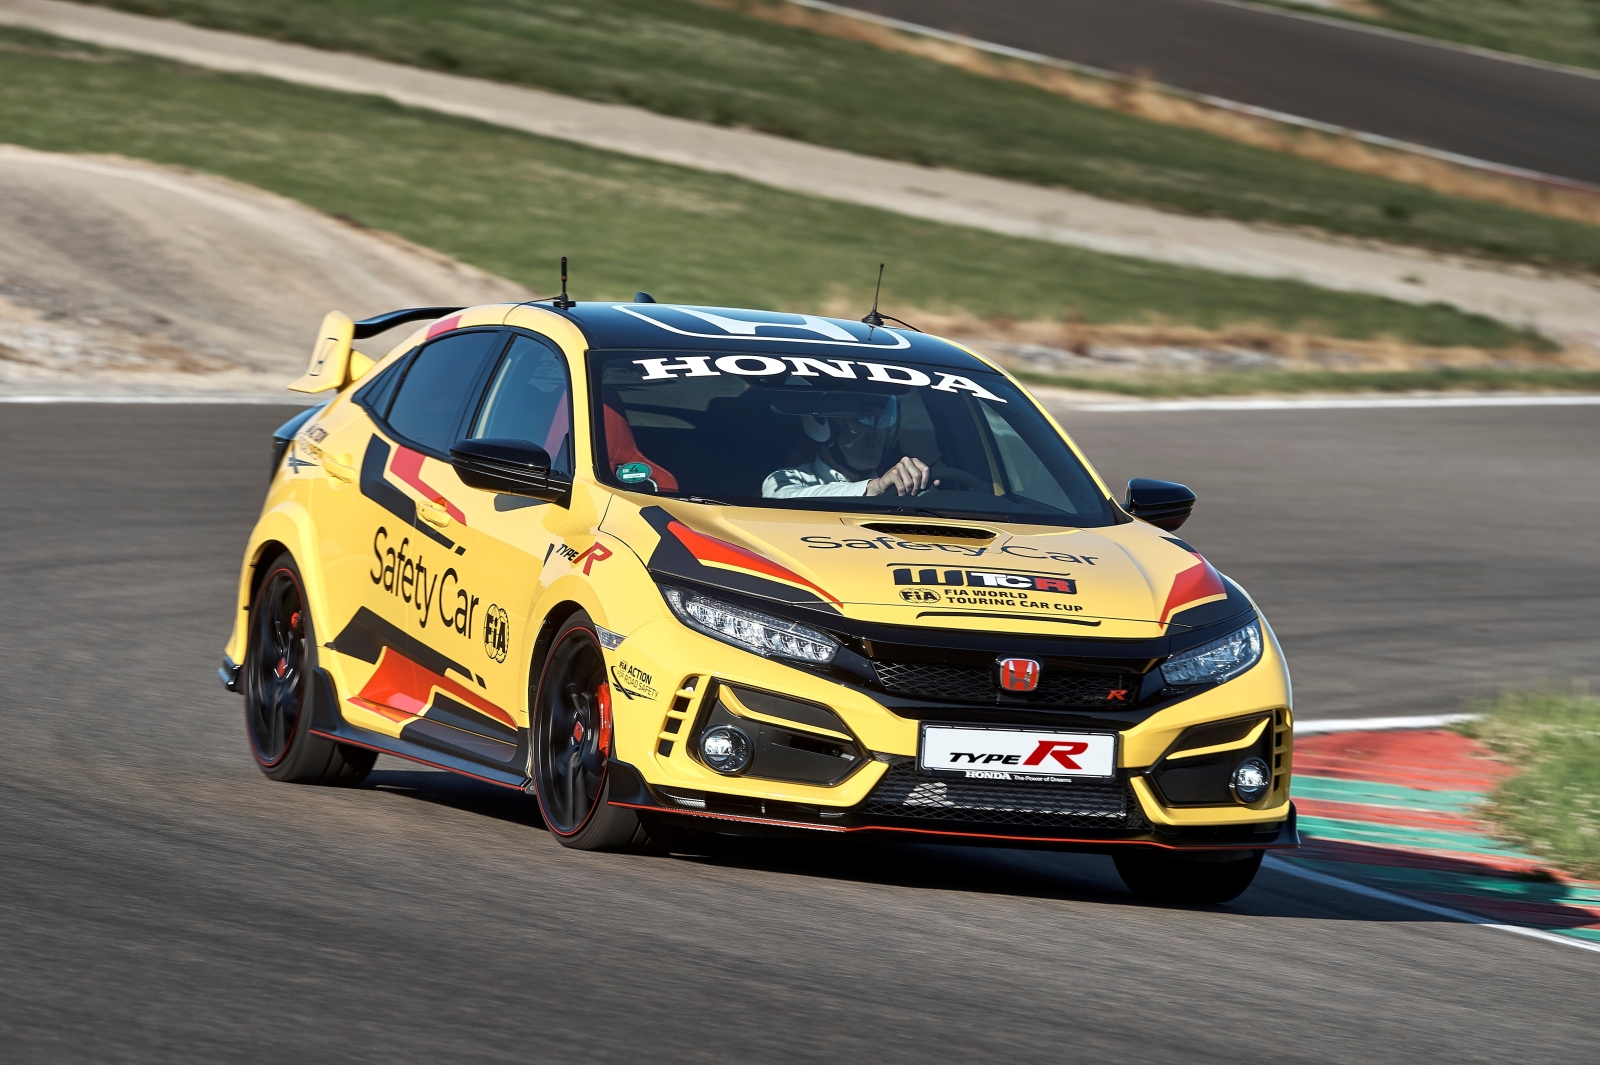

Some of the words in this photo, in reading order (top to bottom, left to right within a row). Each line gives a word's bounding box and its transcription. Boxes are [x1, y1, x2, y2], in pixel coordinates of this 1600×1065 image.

[632, 355, 1008, 404] HONDA
[556, 543, 580, 562] TYPE
[572, 541, 613, 577] R
[800, 535, 987, 557] Safety
[1001, 545, 1099, 566] Car
[370, 526, 438, 629] Safety
[439, 567, 480, 640] Car
[893, 568, 1075, 594] WTCR
[944, 588, 970, 596] FIA
[972, 589, 1028, 599] WORLD
[945, 597, 1016, 607] TOURING
[1020, 600, 1050, 610] CAR
[1054, 603, 1083, 613] CUP
[624, 674, 639, 689] ROAD
[638, 682, 660, 699] SAFETY
[628, 665, 653, 685] ACTION
[1107, 689, 1127, 700] R
[949, 752, 1022, 765] TYPE
[1022, 740, 1089, 770] R
[965, 770, 1013, 781] HONDA
